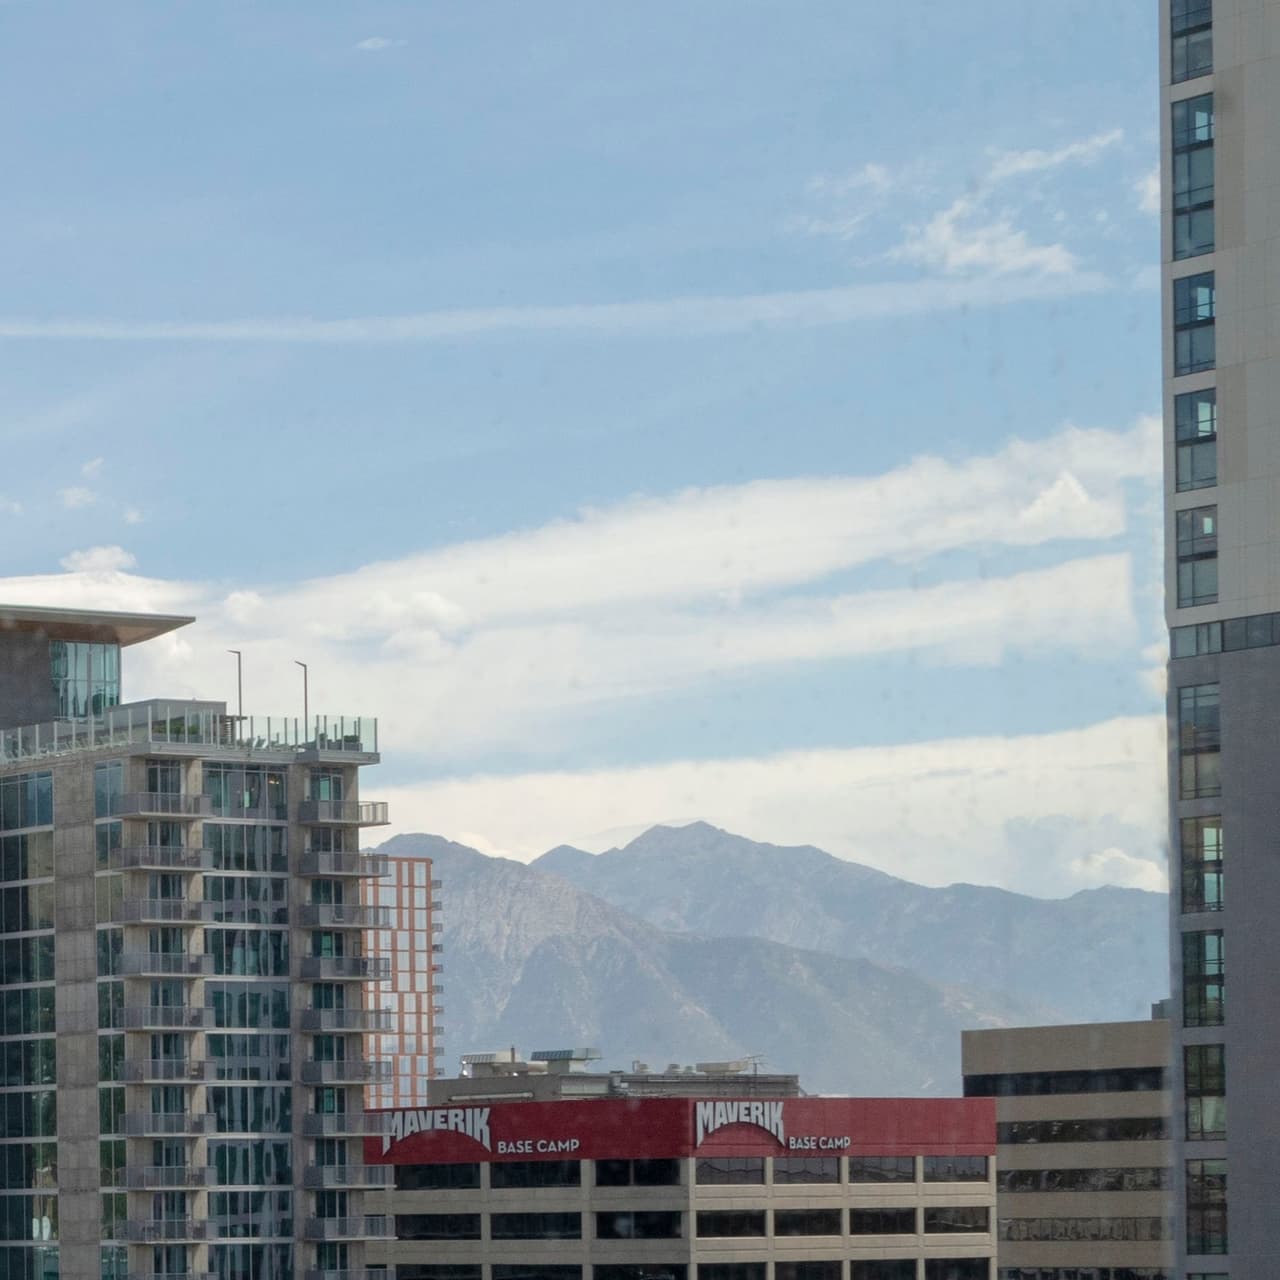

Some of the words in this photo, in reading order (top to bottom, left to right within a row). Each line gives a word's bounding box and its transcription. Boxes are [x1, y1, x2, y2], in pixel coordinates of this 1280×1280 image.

[383, 1107, 491, 1156] MAVERIK
[696, 1101, 785, 1148] MAVERIK
[498, 1140, 533, 1154] BASE
[537, 1138, 580, 1152] CAMP
[789, 1136, 817, 1149] BASE
[819, 1136, 851, 1149] CAMP
